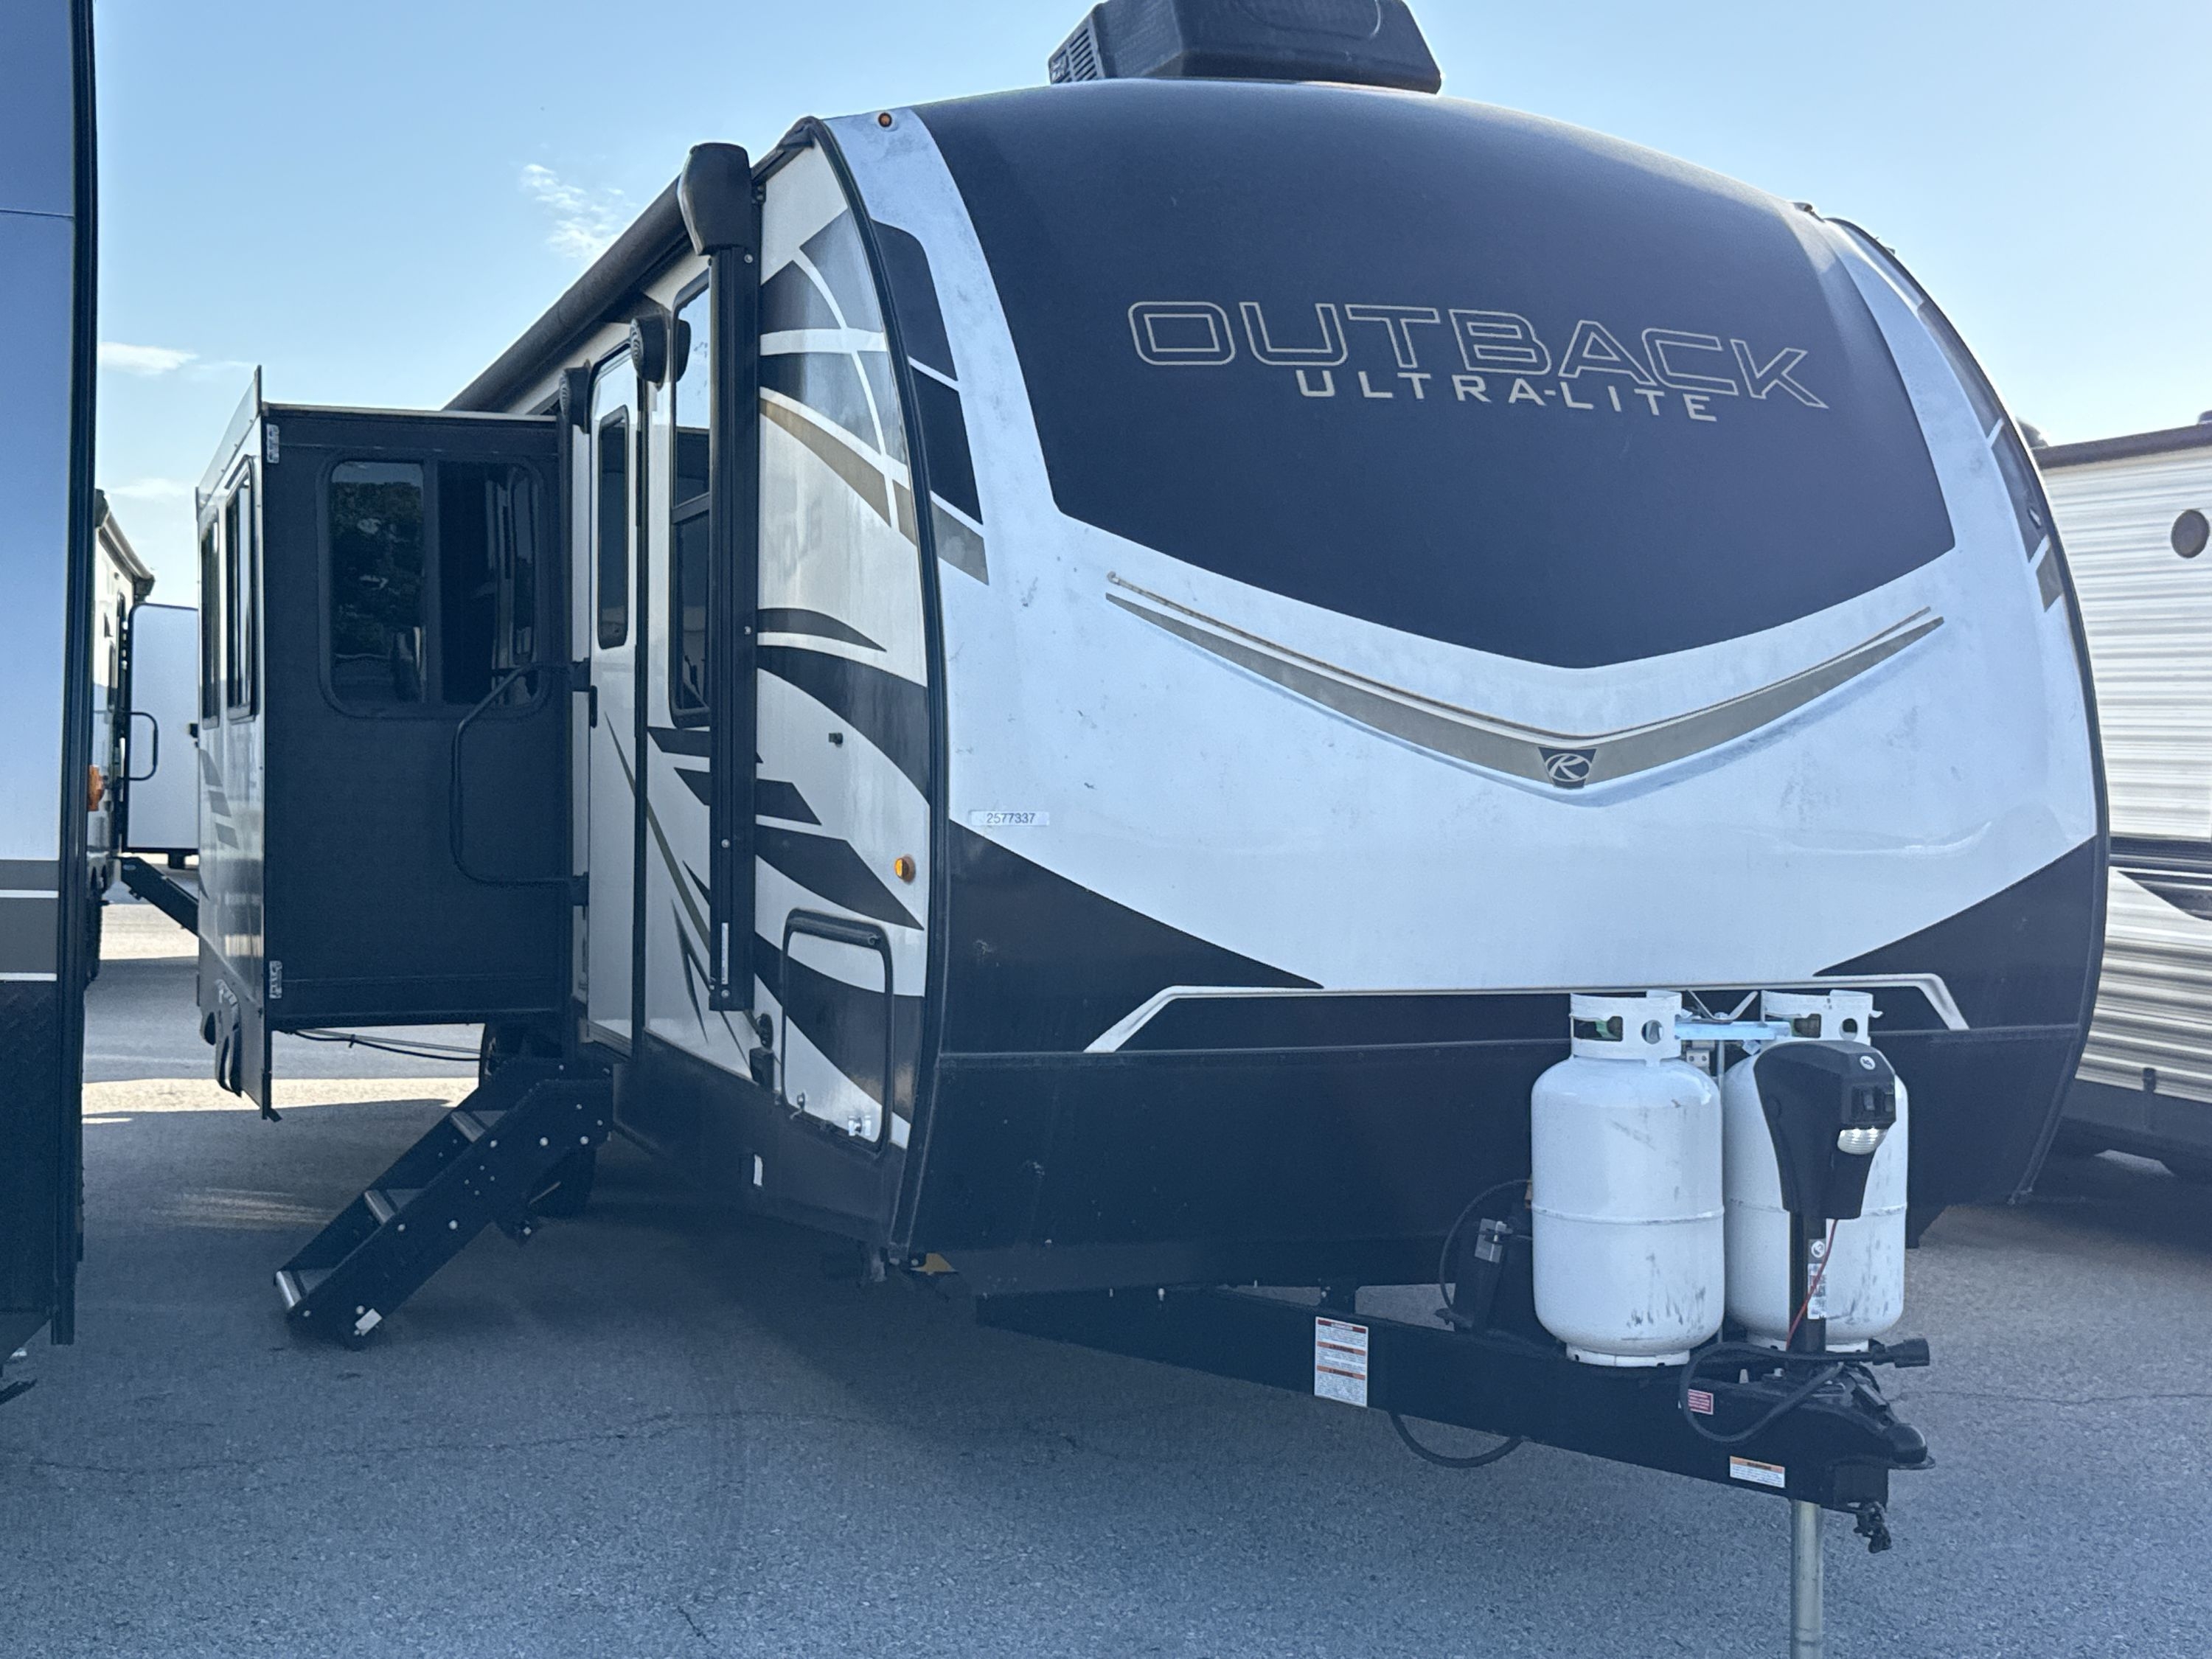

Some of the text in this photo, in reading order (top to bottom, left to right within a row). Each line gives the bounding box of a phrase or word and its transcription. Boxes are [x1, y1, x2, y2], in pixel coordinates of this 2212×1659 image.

[1127, 301, 1829, 409] OUTBACK
[1295, 369, 1719, 424] ULTRA-LITE
[986, 813, 1036, 824] 2577337
